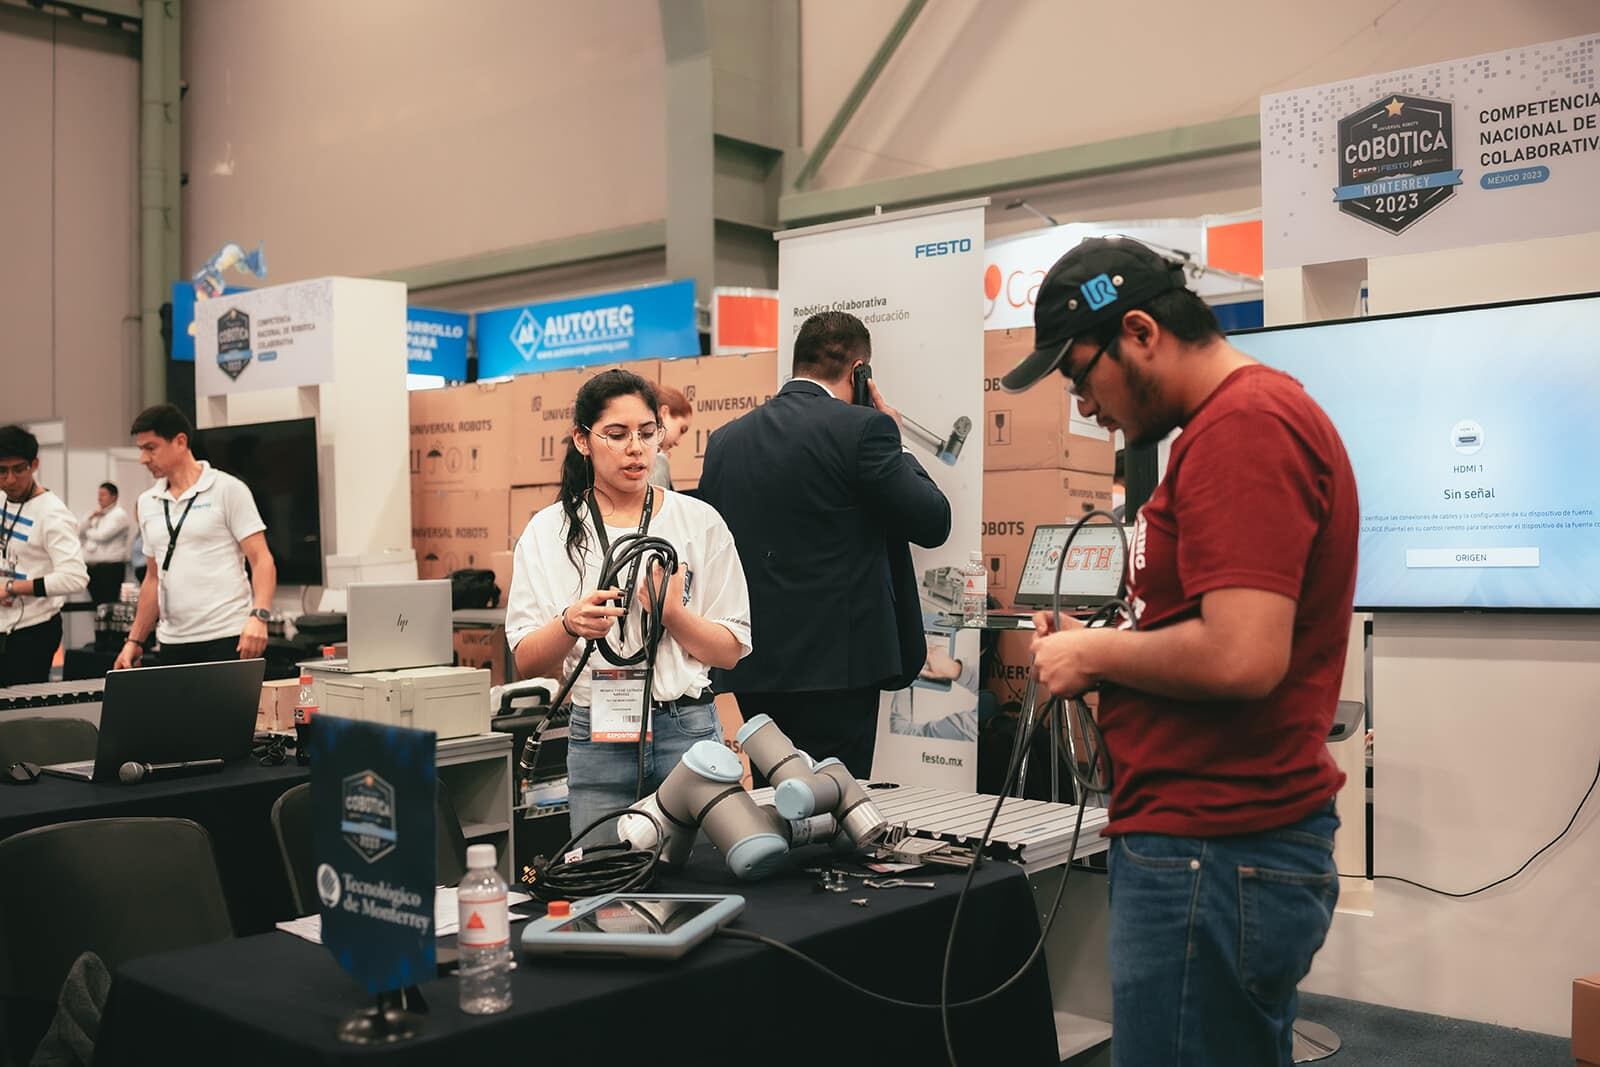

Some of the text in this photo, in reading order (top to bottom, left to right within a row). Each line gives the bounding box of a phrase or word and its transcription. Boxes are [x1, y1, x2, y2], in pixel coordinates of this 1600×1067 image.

[1480, 92, 1600, 124] COMPETENCIA
[1480, 114, 1597, 146] NACIONAL DE
[1345, 129, 1448, 164] COBOTICA
[1480, 136, 1600, 166] COLABORATIV
[1522, 170, 1542, 180] 2023
[1363, 176, 1430, 196] MONTERREY
[1375, 193, 1419, 213] 2023
[915, 239, 971, 258] FESTO
[793, 296, 887, 318] Robótica Colaborativa
[864, 309, 910, 324] educación
[543, 304, 634, 337] AUTOTEC
[697, 396, 758, 412] UNIVERSAL
[1453, 465, 1476, 473] HDMI
[1444, 487, 1496, 500] Sin señal
[981, 521, 1024, 536] OBOTS
[1065, 545, 1115, 571] CTH
[1455, 553, 1487, 561] ORIGEN
[921, 751, 963, 767] festo.mx
[342, 873, 422, 907] Tecnológico
[343, 895, 431, 935] de Monterrey
